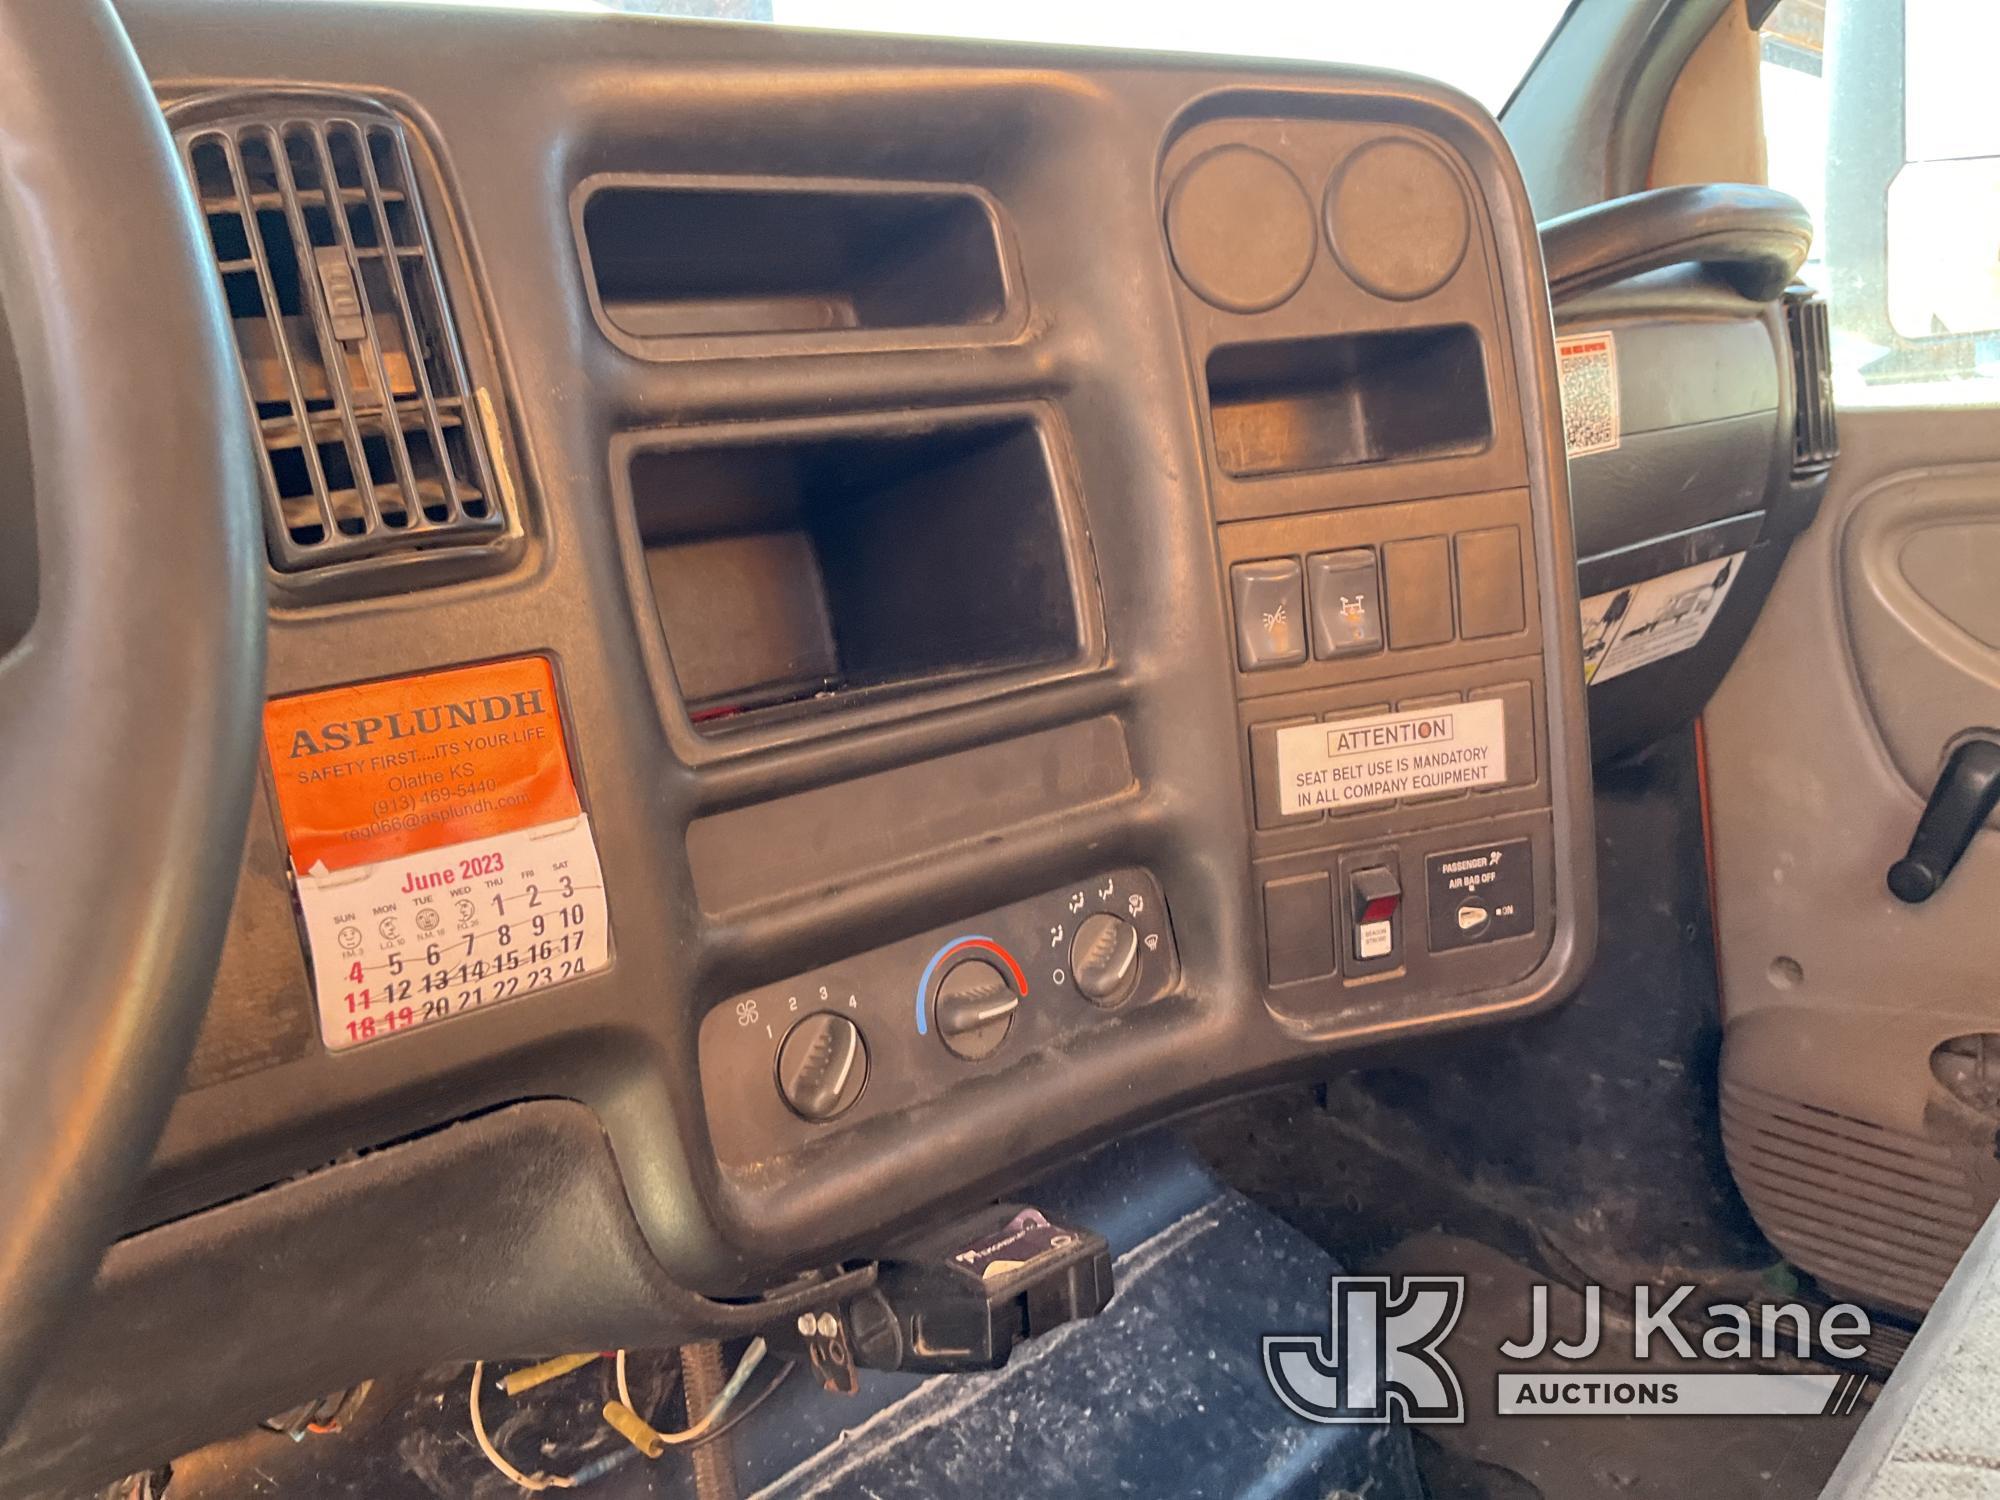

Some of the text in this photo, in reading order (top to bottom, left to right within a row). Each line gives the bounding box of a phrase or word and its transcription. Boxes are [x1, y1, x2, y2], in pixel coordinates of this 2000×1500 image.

[289, 689, 545, 758] ASPLUNDH
[1337, 719, 1446, 751] ATTENTION
[298, 760, 365, 784] SAFETY
[465, 734, 510, 753] YOUR
[514, 726, 545, 743] LIFE
[1296, 746, 1488, 787] SEAT BELT USE IS MANDATORY
[389, 763, 474, 792] Olathe KS
[1298, 766, 1488, 807] IN ALL COMPANY EQUIPMENT
[373, 794, 416, 818] (913)
[401, 852, 504, 893] June 2023
[1442, 857, 1487, 874] PASSENGER
[1449, 872, 1496, 889] AIR BAG OFF
[334, 861, 569, 924] SUN MON TUE WED THU FRI SAT
[493, 875, 573, 915] 1 2 3
[349, 903, 584, 984] 4 5 6 7 8 9 10
[344, 931, 583, 1013] 11 12 13 14 15 16 17
[346, 957, 585, 1041] 18 19 20 21 22 23 24
[766, 986, 857, 1039] 1 2 3 4
